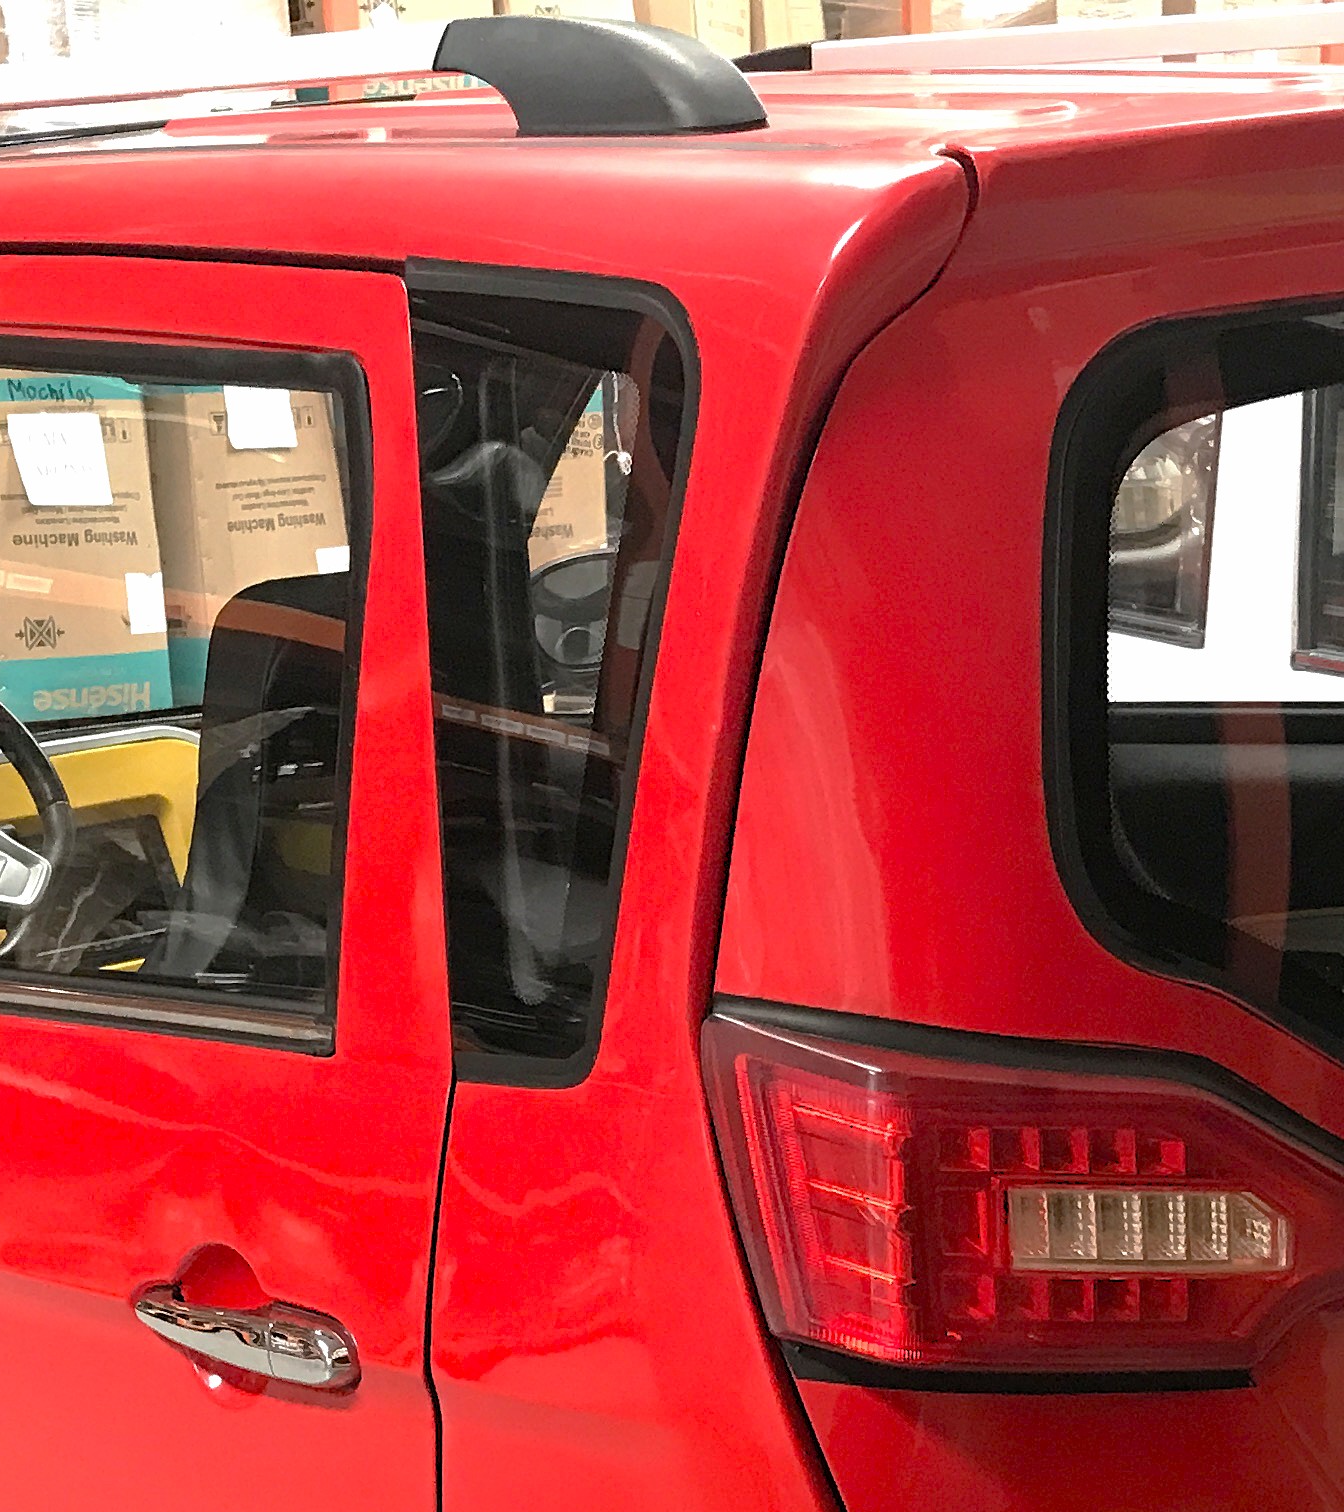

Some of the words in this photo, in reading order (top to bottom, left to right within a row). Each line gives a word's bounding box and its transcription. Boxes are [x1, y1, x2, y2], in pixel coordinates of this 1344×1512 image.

[7, 378, 95, 406] Mochilas
[226, 518, 276, 534] Machine
[277, 513, 326, 529] Washing
[12, 533, 80, 549] Machine
[84, 529, 138, 546] Washing
[33, 681, 151, 712] Hisense
